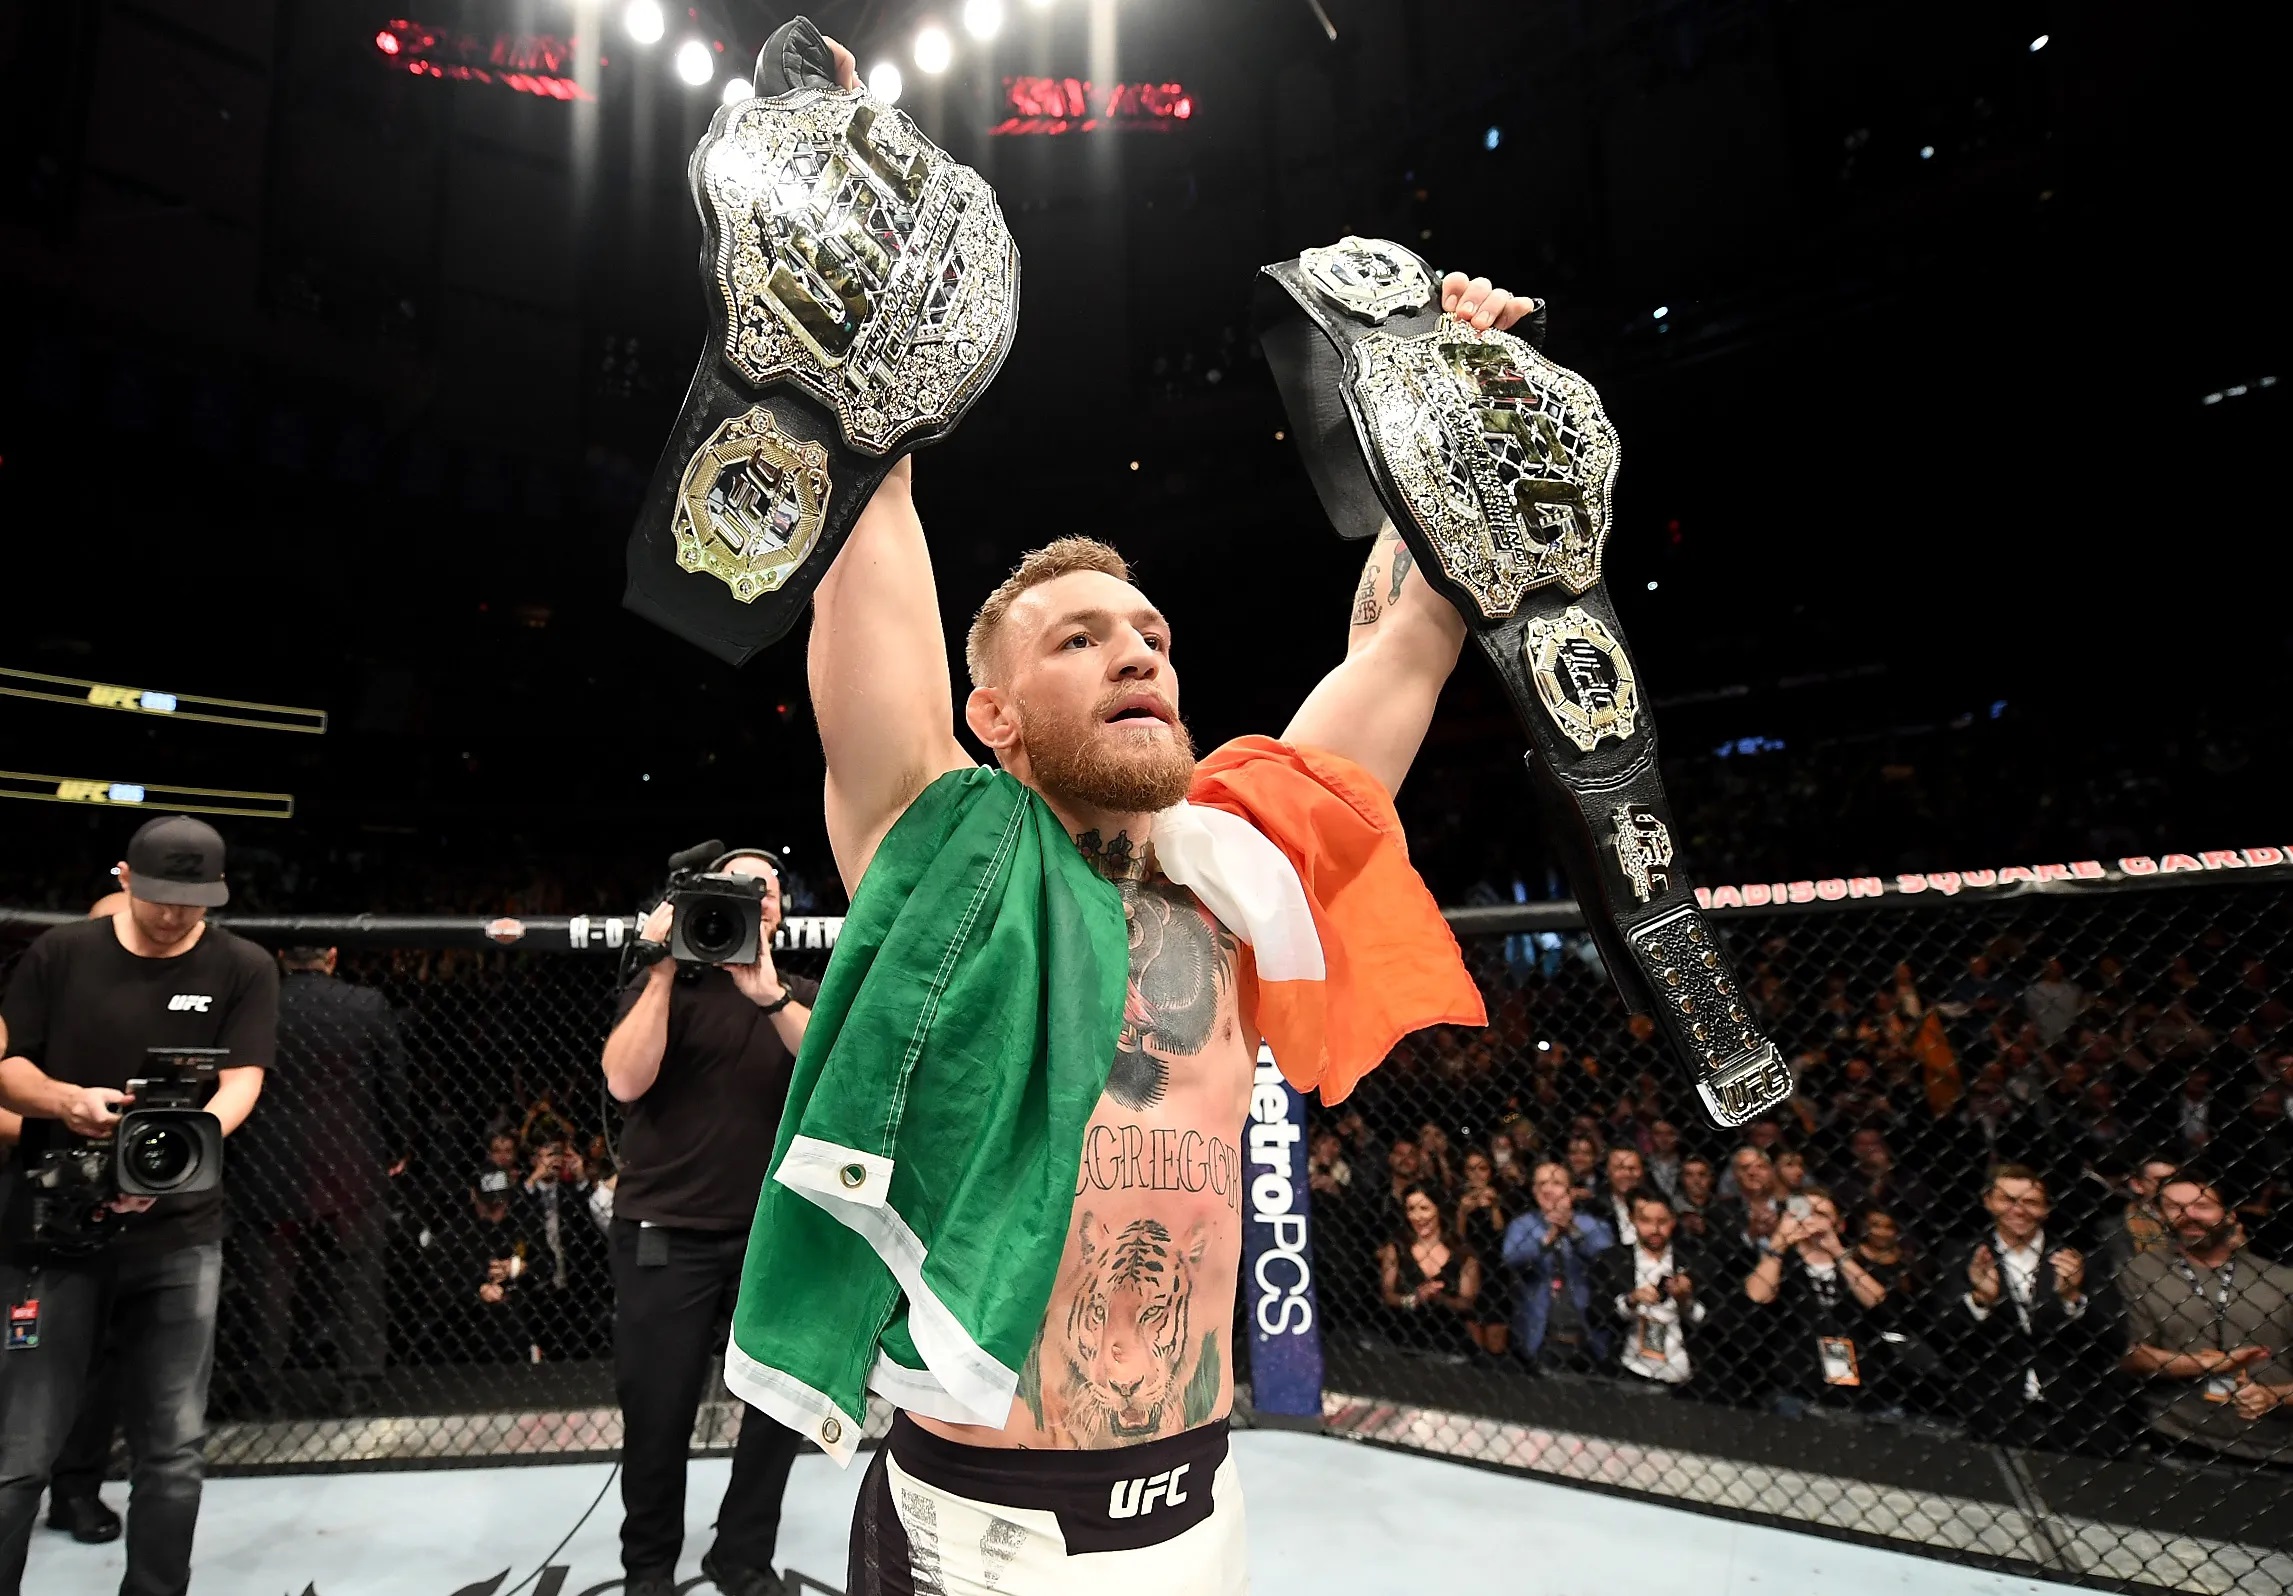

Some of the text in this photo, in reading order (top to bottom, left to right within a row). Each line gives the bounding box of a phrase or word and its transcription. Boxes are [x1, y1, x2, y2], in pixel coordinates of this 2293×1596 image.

[1896, 860, 2105, 896] SQUARE
[569, 917, 846, 949] H-D TAR
[167, 994, 213, 1012] UFC
[1722, 1062, 1787, 1118] UFC
[1075, 1125, 1240, 1214] GREGOR
[1108, 1462, 1191, 1519] UFC
